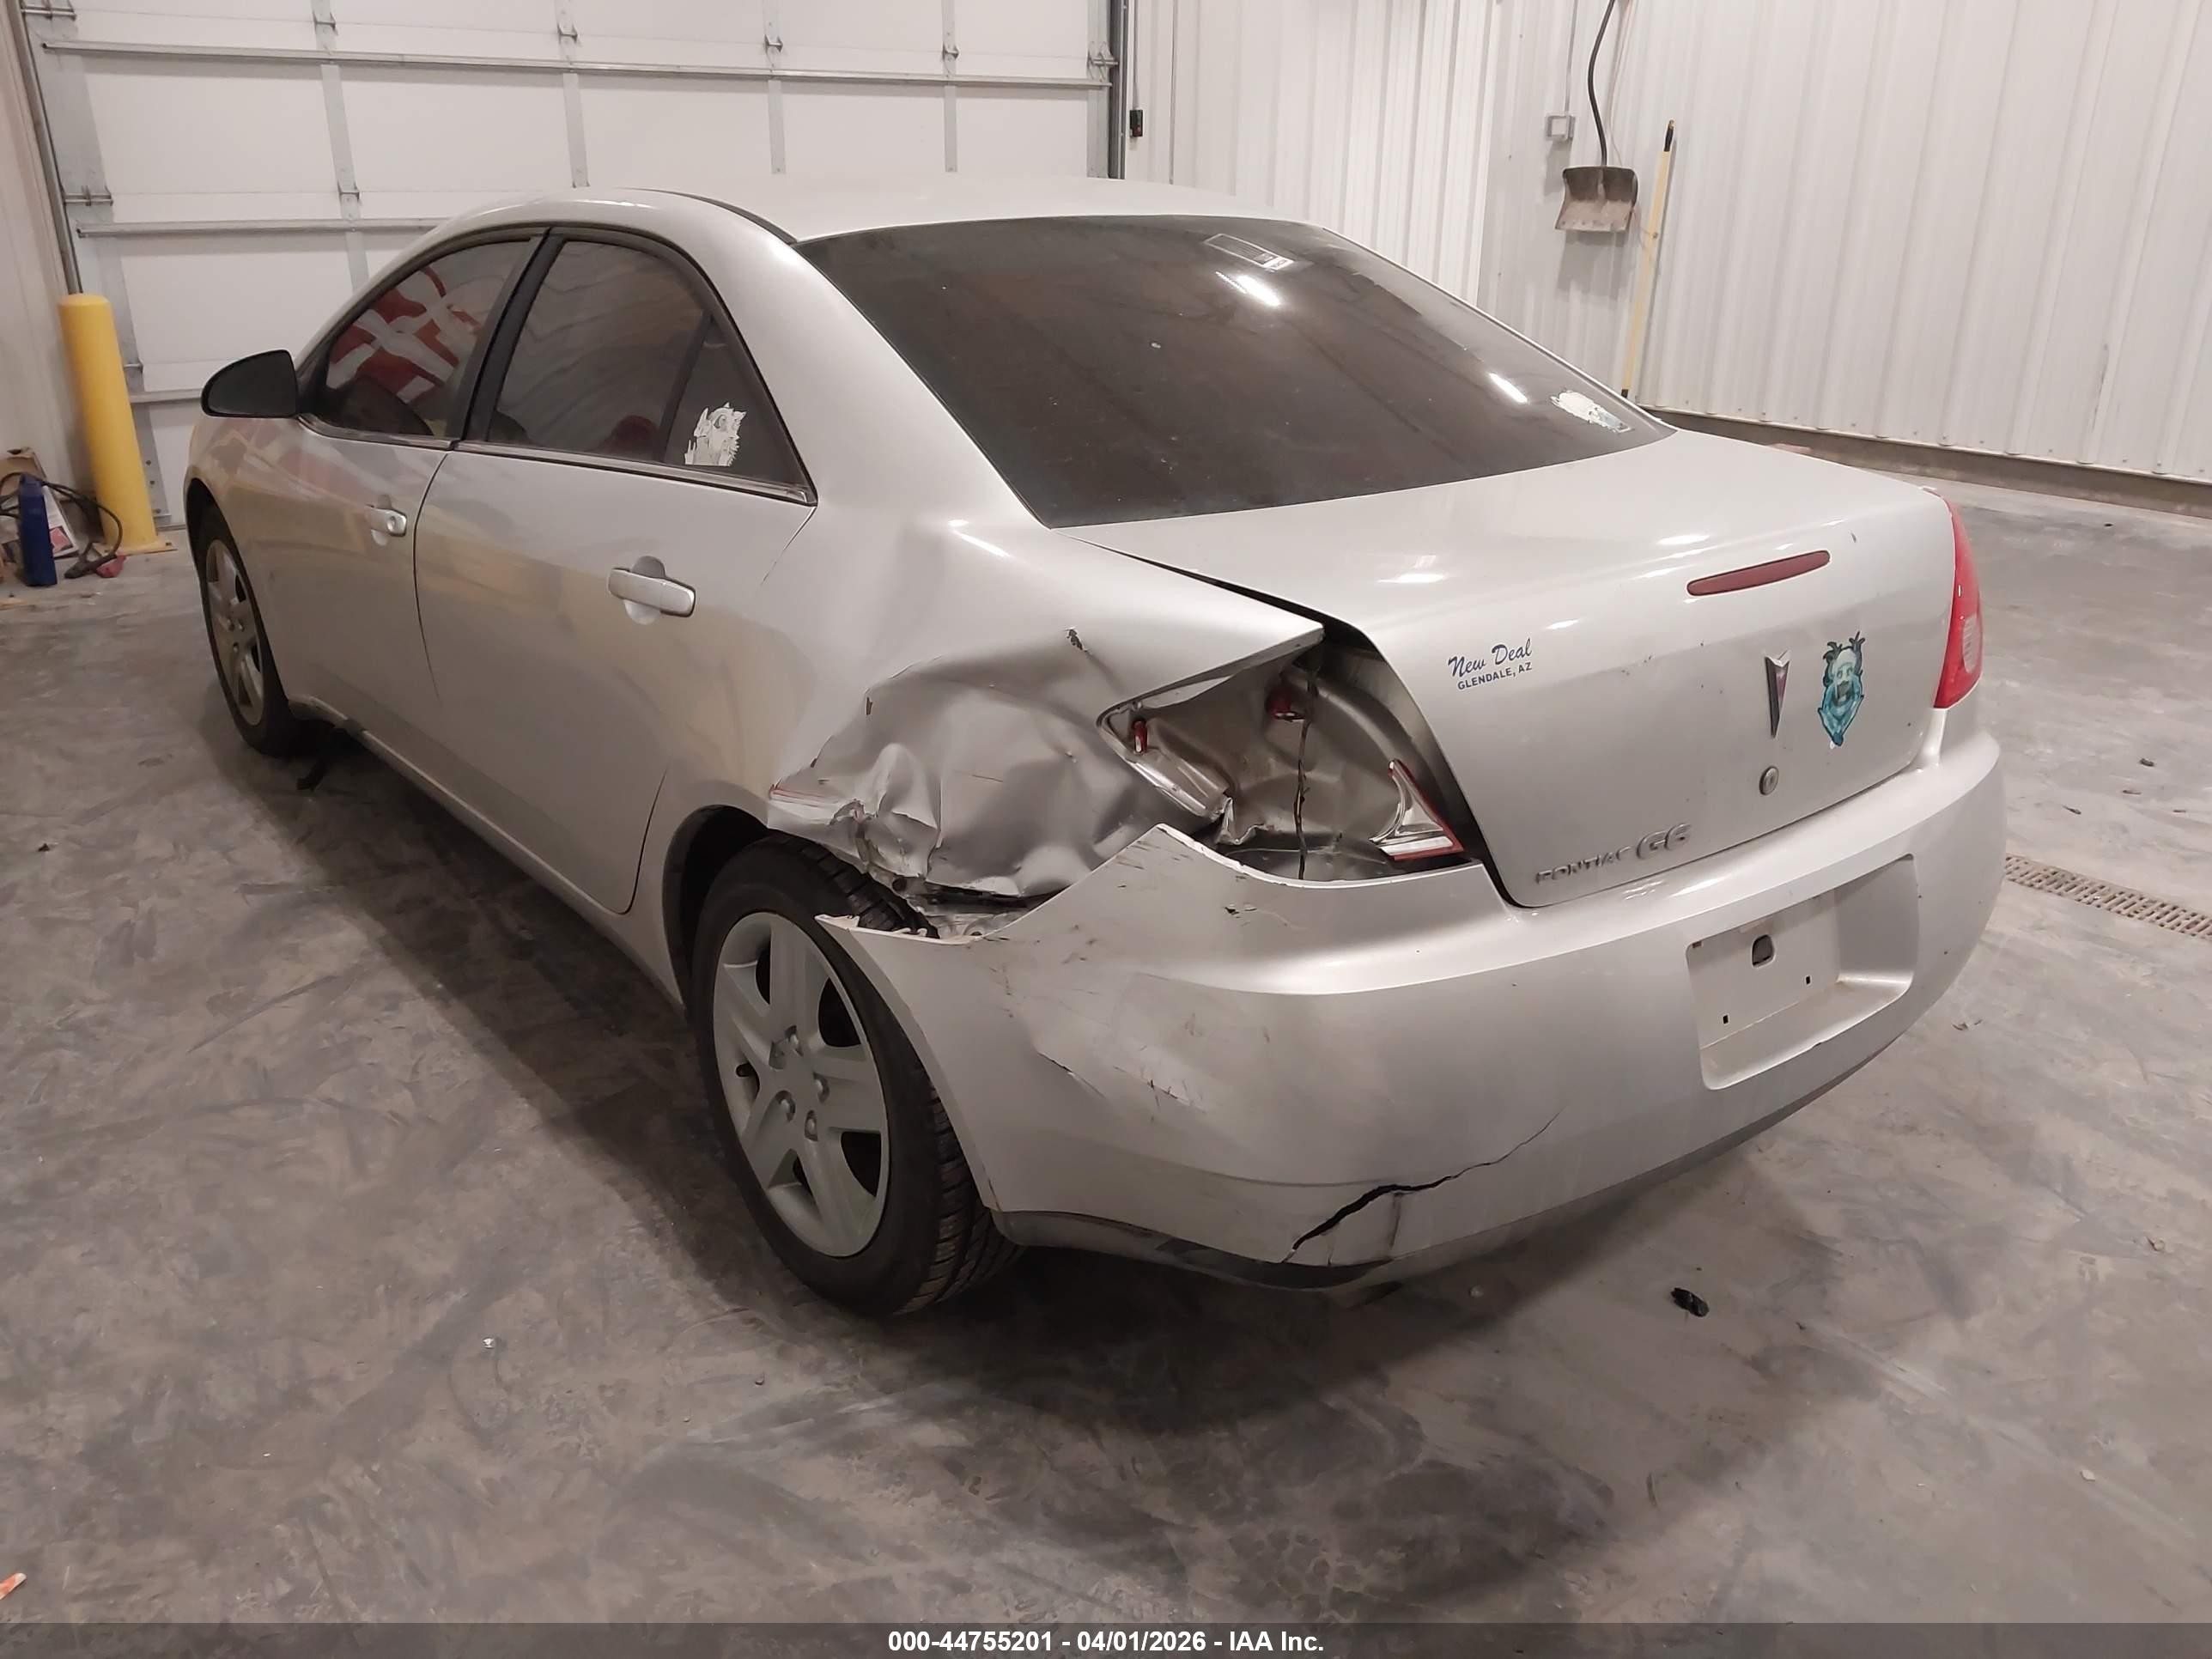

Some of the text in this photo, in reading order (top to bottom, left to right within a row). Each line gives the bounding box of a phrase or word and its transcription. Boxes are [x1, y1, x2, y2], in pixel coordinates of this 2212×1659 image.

[1448, 637, 1533, 678] New Deal
[1457, 661, 1533, 690] GLENDALE, AZ
[1635, 822, 1692, 860] G6
